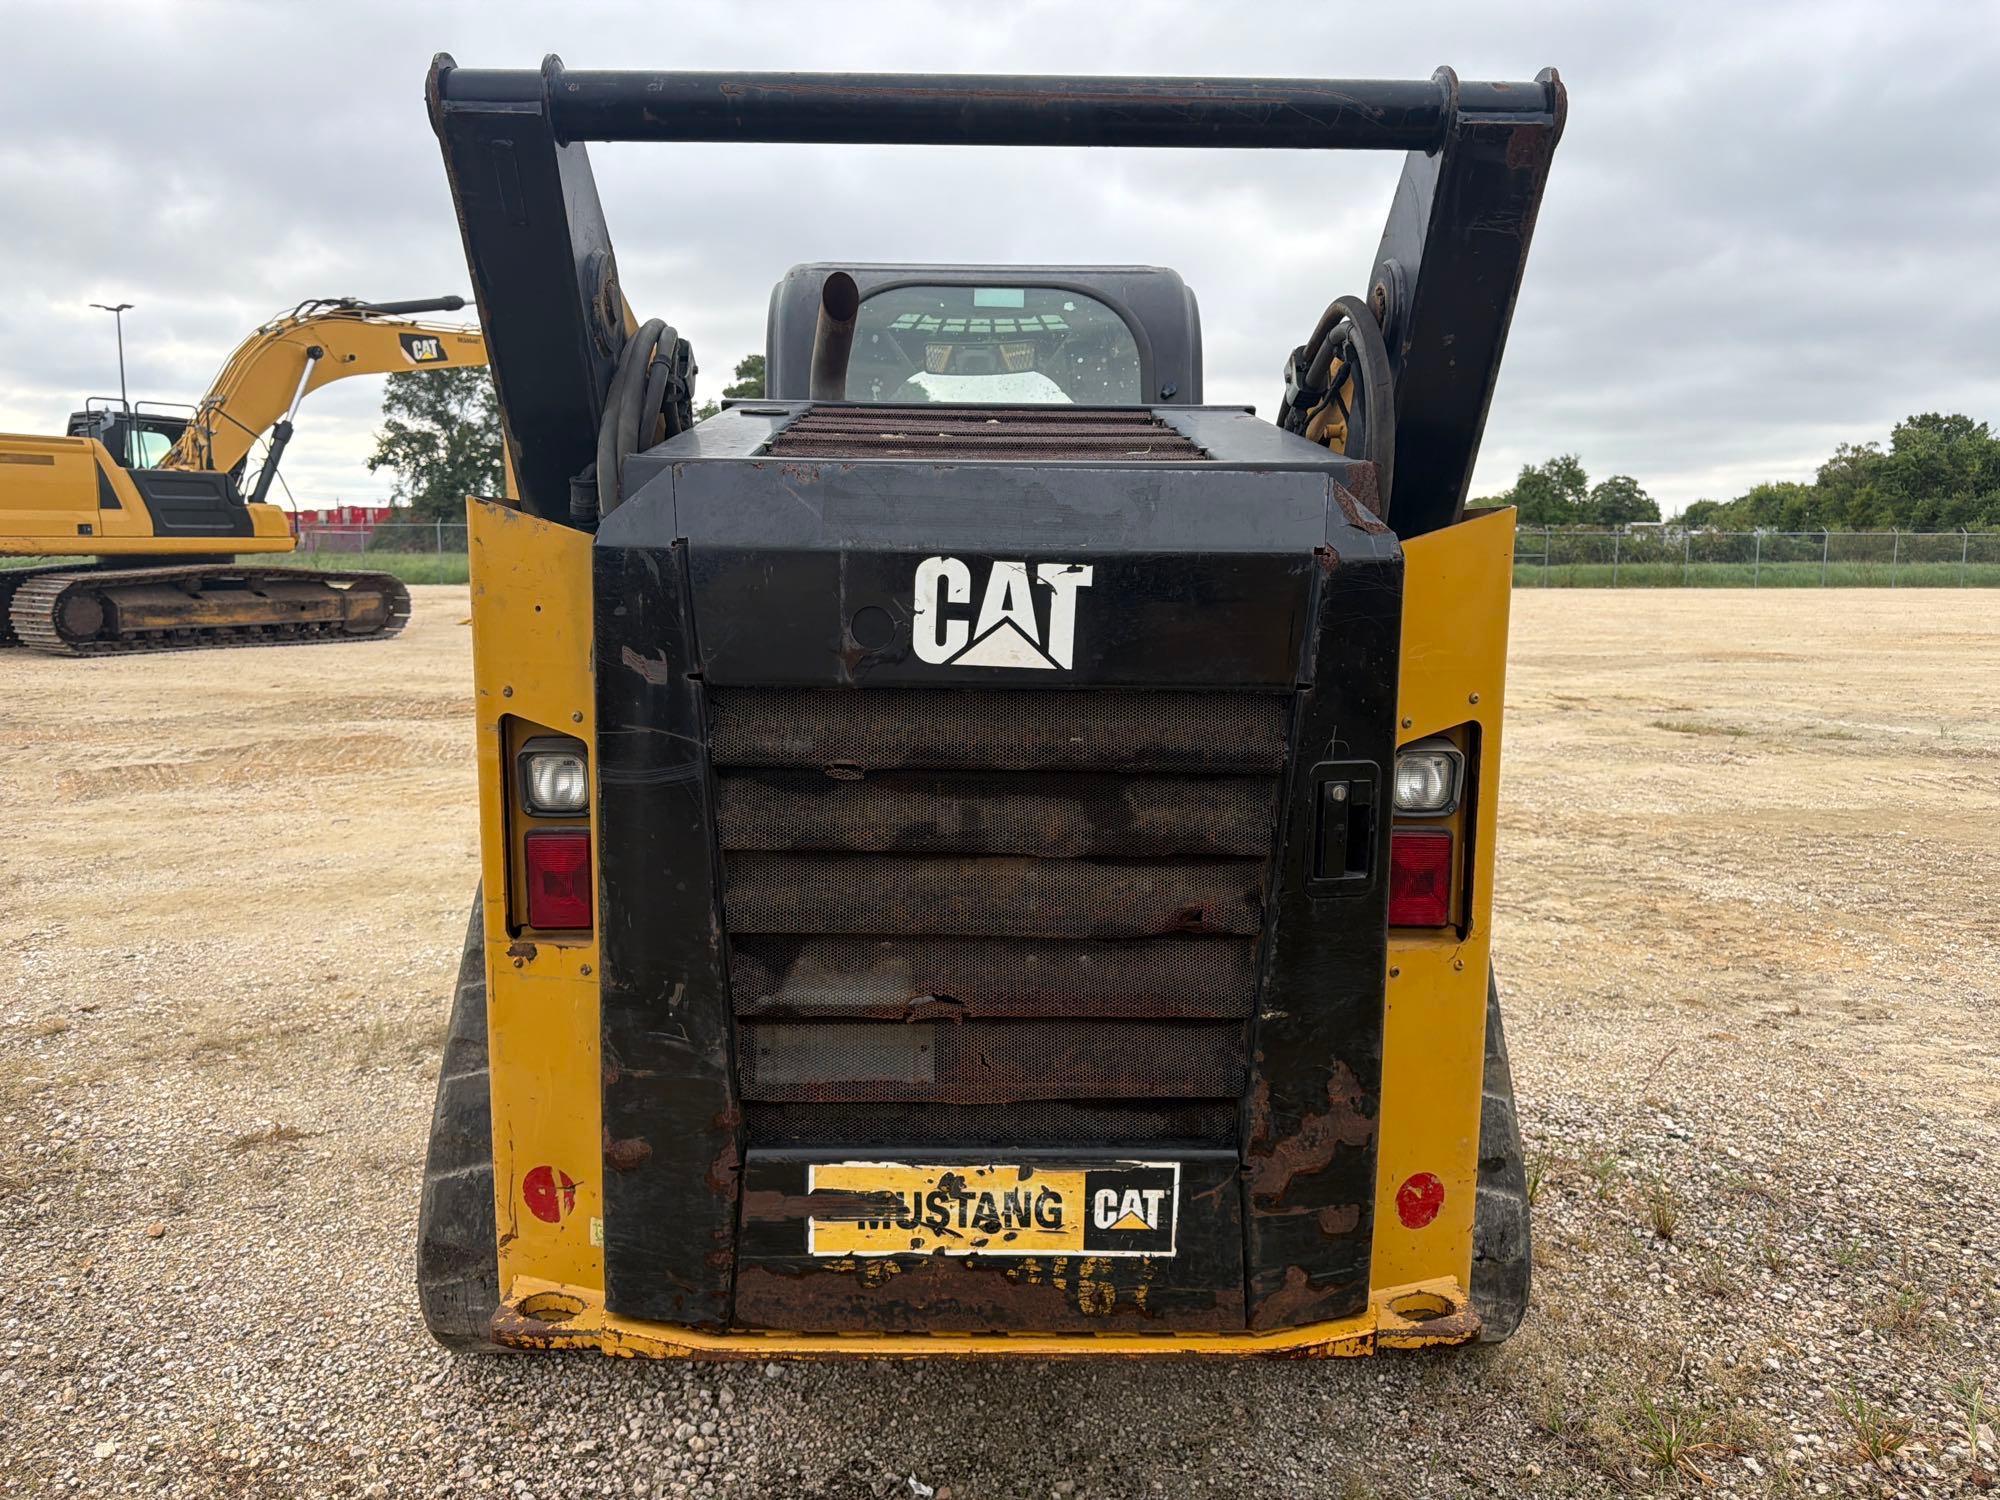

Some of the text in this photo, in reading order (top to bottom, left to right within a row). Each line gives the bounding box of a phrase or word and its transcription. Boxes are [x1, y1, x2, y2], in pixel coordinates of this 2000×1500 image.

[412, 339, 438, 360] CAT
[912, 556, 1093, 670] CAT
[1093, 1188, 1166, 1231] CAT
